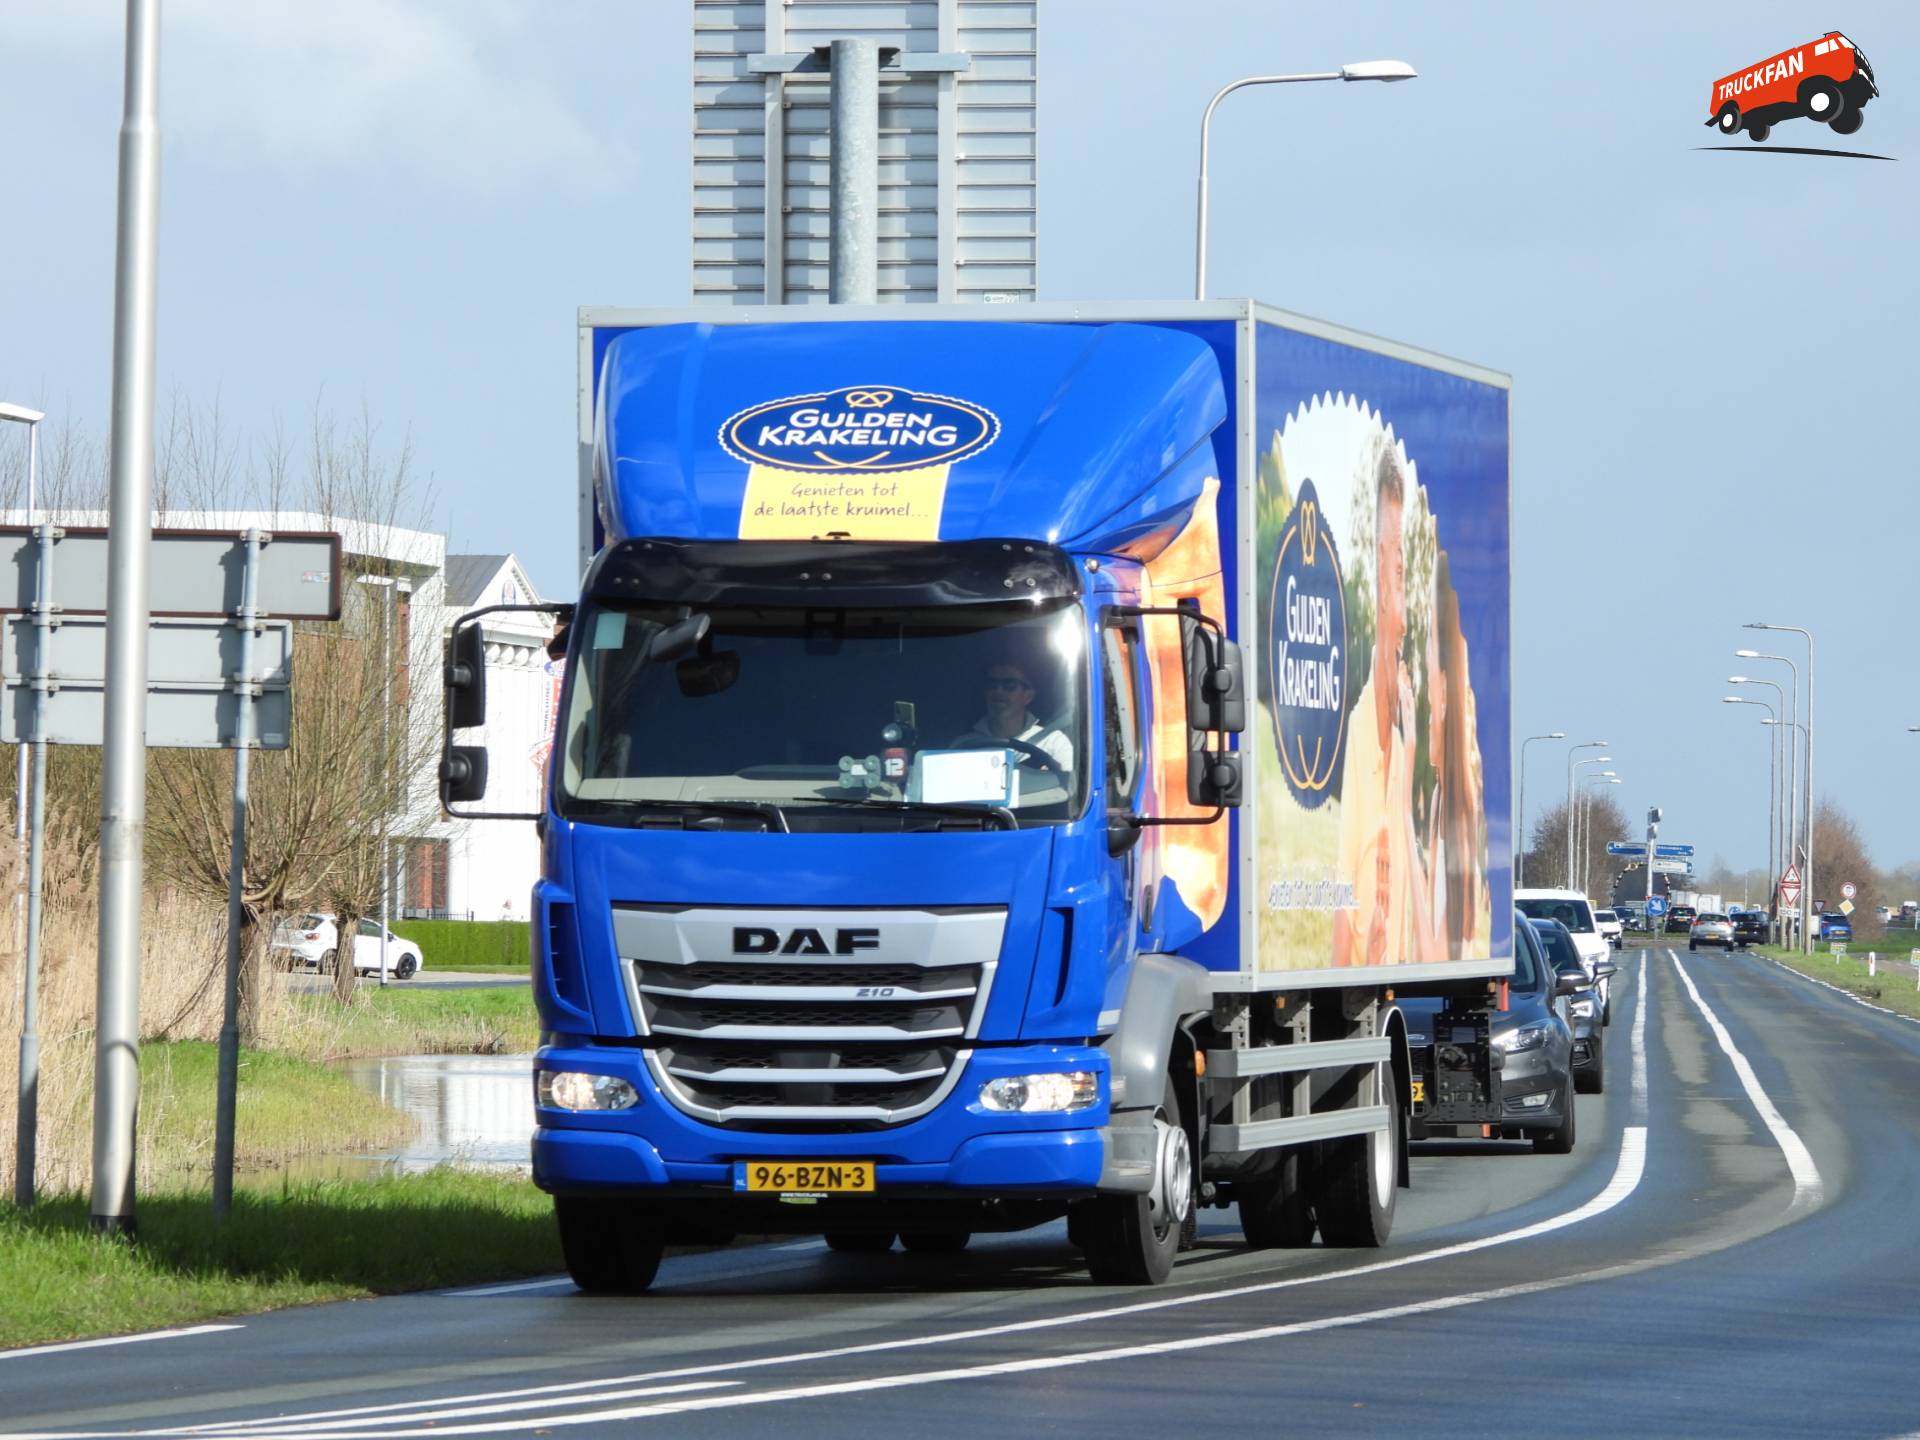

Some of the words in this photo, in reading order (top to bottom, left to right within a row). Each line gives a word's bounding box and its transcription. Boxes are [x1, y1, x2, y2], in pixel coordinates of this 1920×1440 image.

[789, 408, 933, 428] GULDEN
[757, 425, 958, 447] KRAKELING
[791, 482, 865, 498] Genieten
[871, 482, 899, 497] tot
[754, 501, 775, 517] de
[780, 500, 840, 517] laatste
[1286, 574, 1331, 646] GULDEN
[1279, 639, 1340, 712] KRAKELING
[732, 927, 880, 956] DAF
[855, 988, 895, 998] 210
[755, 1166, 866, 1189] 96-BZN-3
